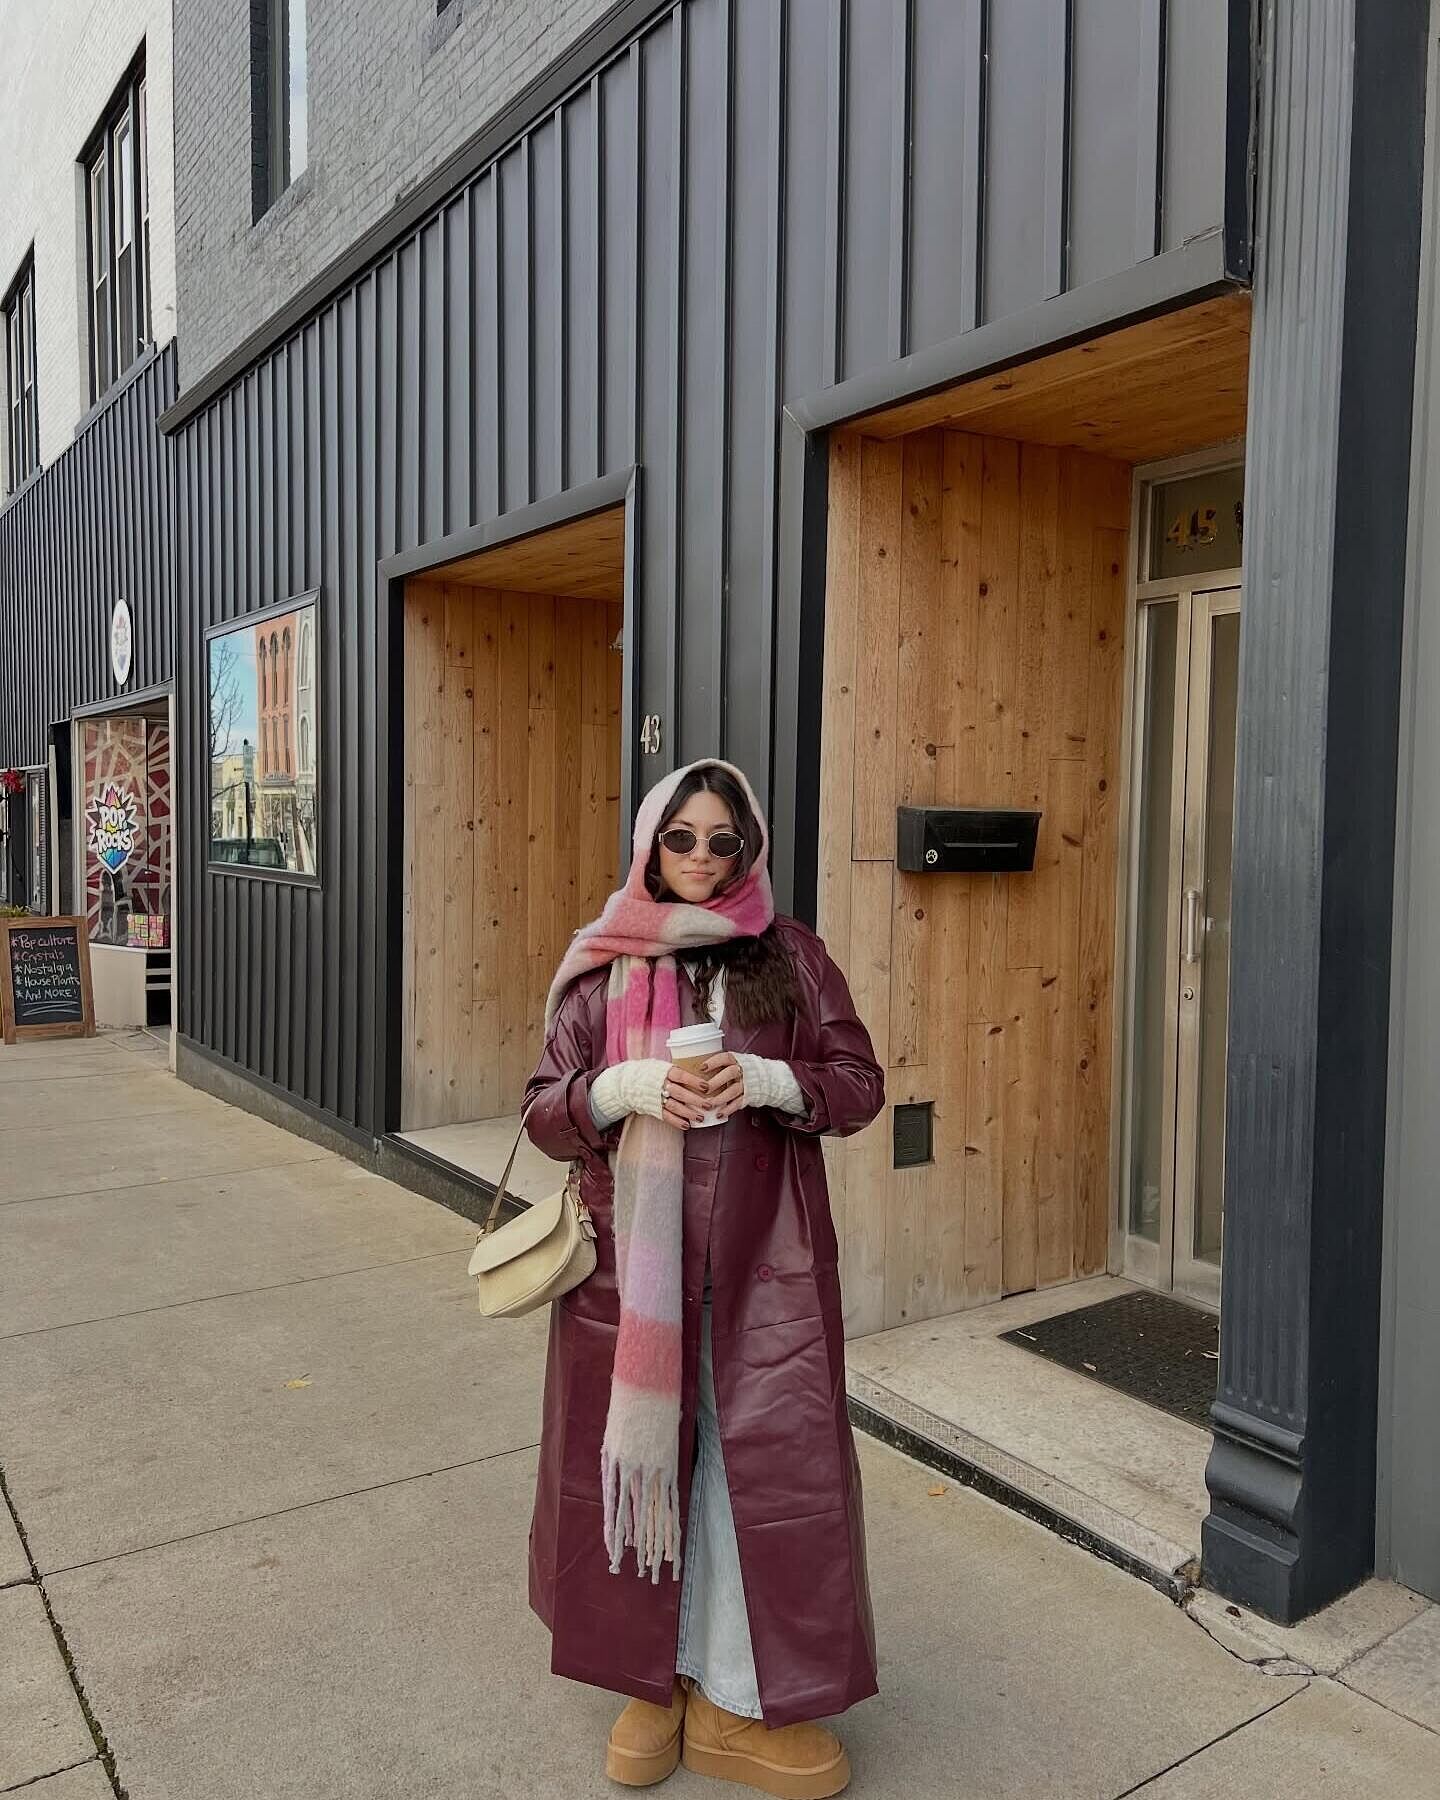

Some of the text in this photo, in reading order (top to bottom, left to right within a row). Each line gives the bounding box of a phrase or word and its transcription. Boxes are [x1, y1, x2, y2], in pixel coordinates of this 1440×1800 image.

[640, 714, 660, 754] 43
[99, 806, 125, 830] POP
[95, 828, 132, 853] ROCKS
[24, 961, 73, 976] Nostalgia
